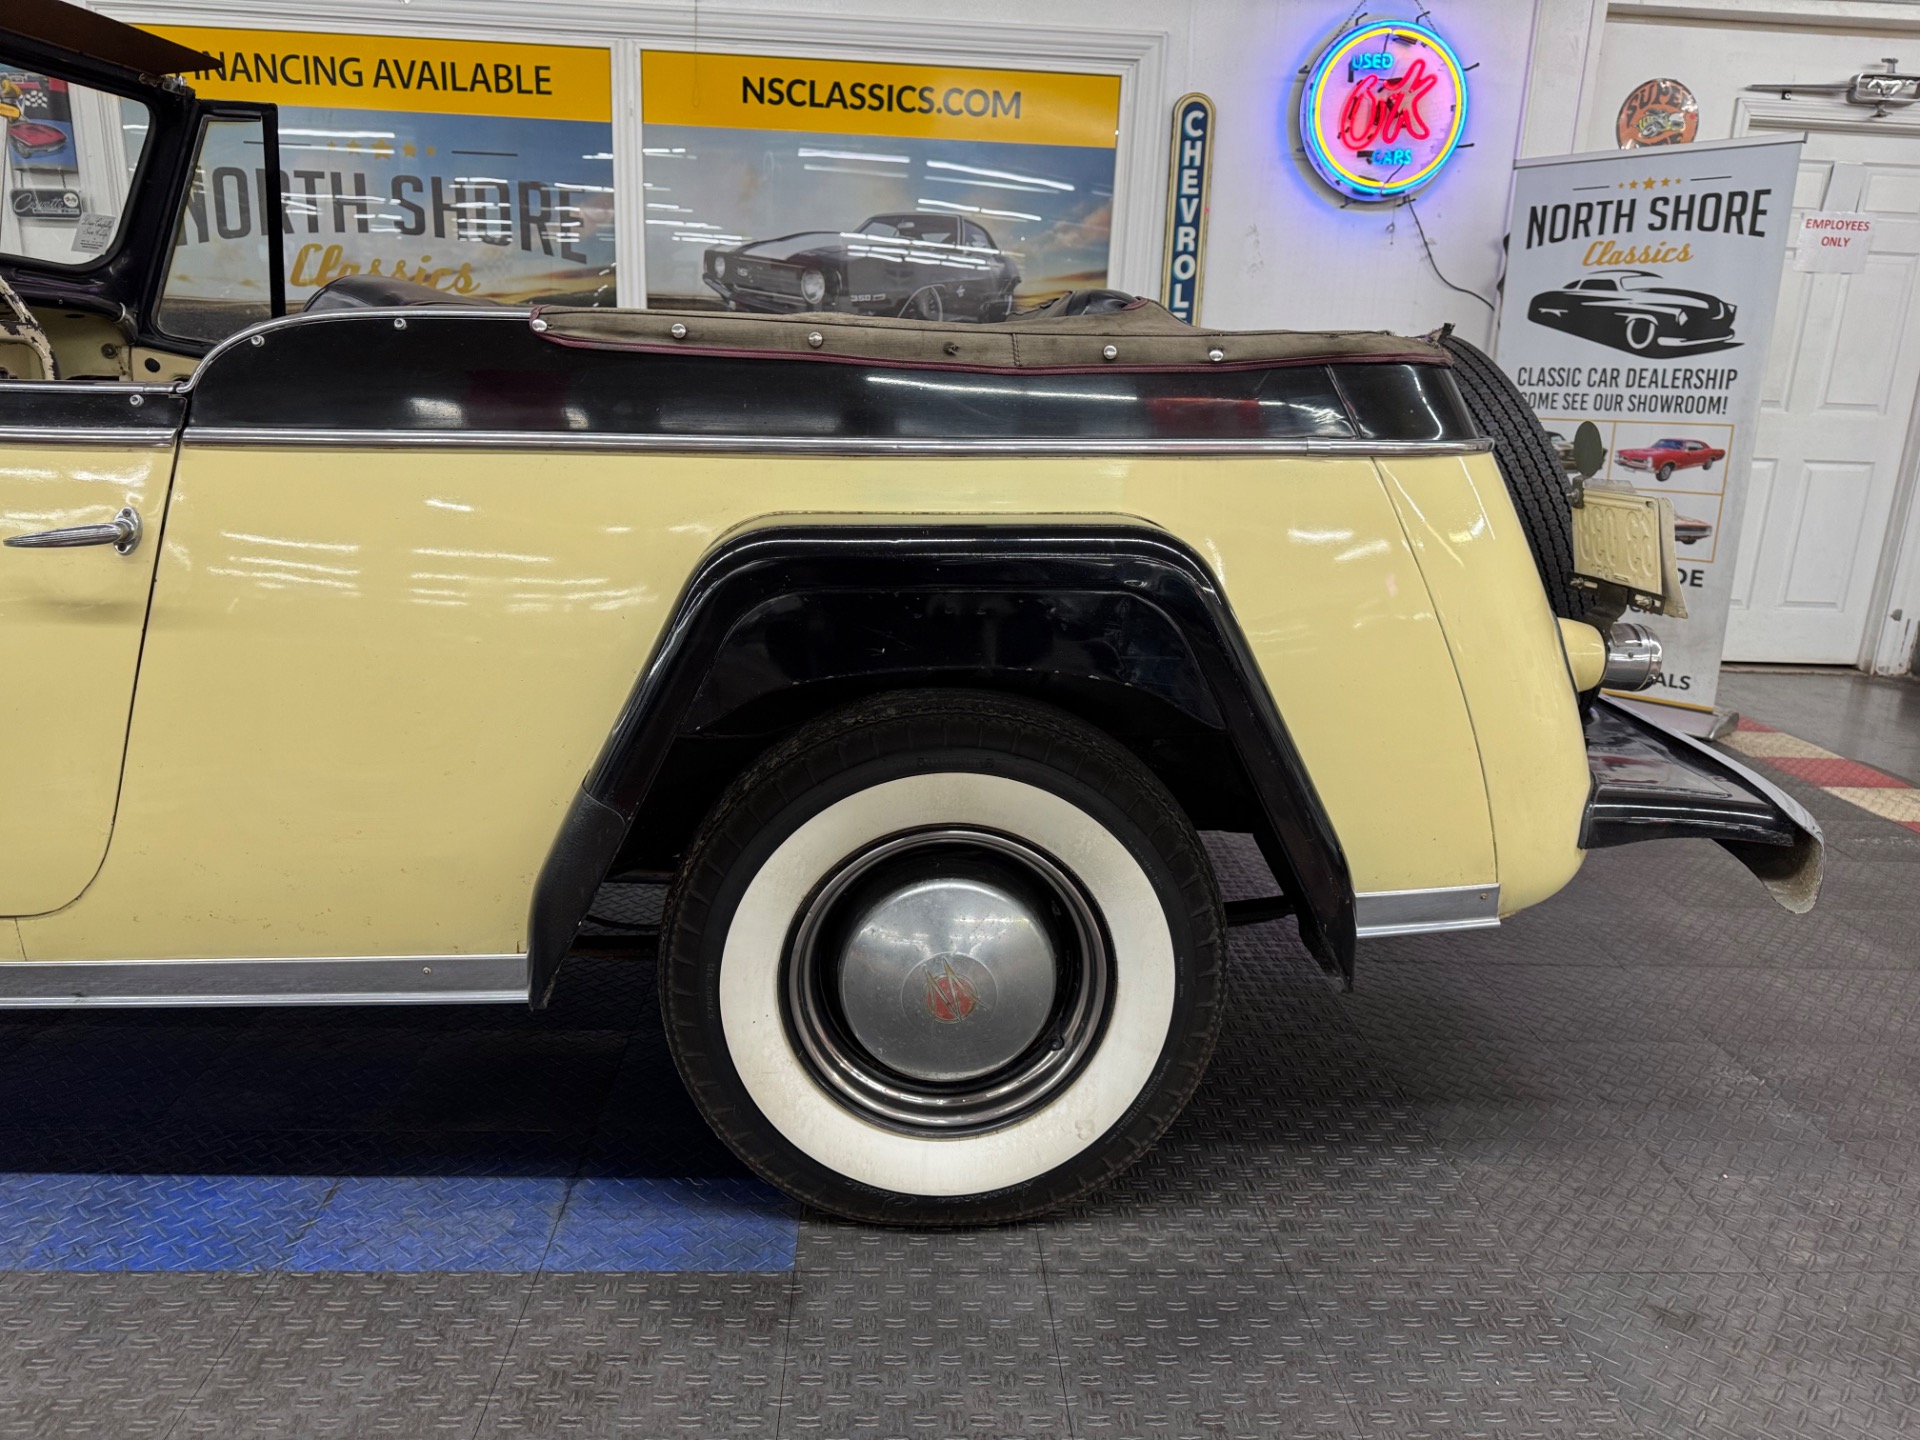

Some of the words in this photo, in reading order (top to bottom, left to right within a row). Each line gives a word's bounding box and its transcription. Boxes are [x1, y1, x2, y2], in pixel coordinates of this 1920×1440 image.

[175, 50, 364, 88] NANCING
[373, 58, 553, 96] AVAILABLE
[1351, 52, 1394, 70] USED
[742, 76, 1022, 119] NSCLASSICS.COM
[1371, 147, 1413, 165] CARS
[391, 175, 588, 264] SHORE
[1526, 199, 1637, 250] NORTH
[1647, 188, 1772, 238] SHORE
[1805, 218, 1871, 232] EMPLOYEES
[1582, 240, 1694, 267] Classics
[1821, 235, 1851, 248] ONLY
[1517, 366, 1582, 388] CLASSIC
[1587, 367, 1620, 389] CAR
[1625, 368, 1738, 391] DEALERSHIP
[1562, 392, 1590, 411] SEE
[1593, 393, 1624, 413] OUR
[1627, 394, 1729, 415] SHOWROOM!
